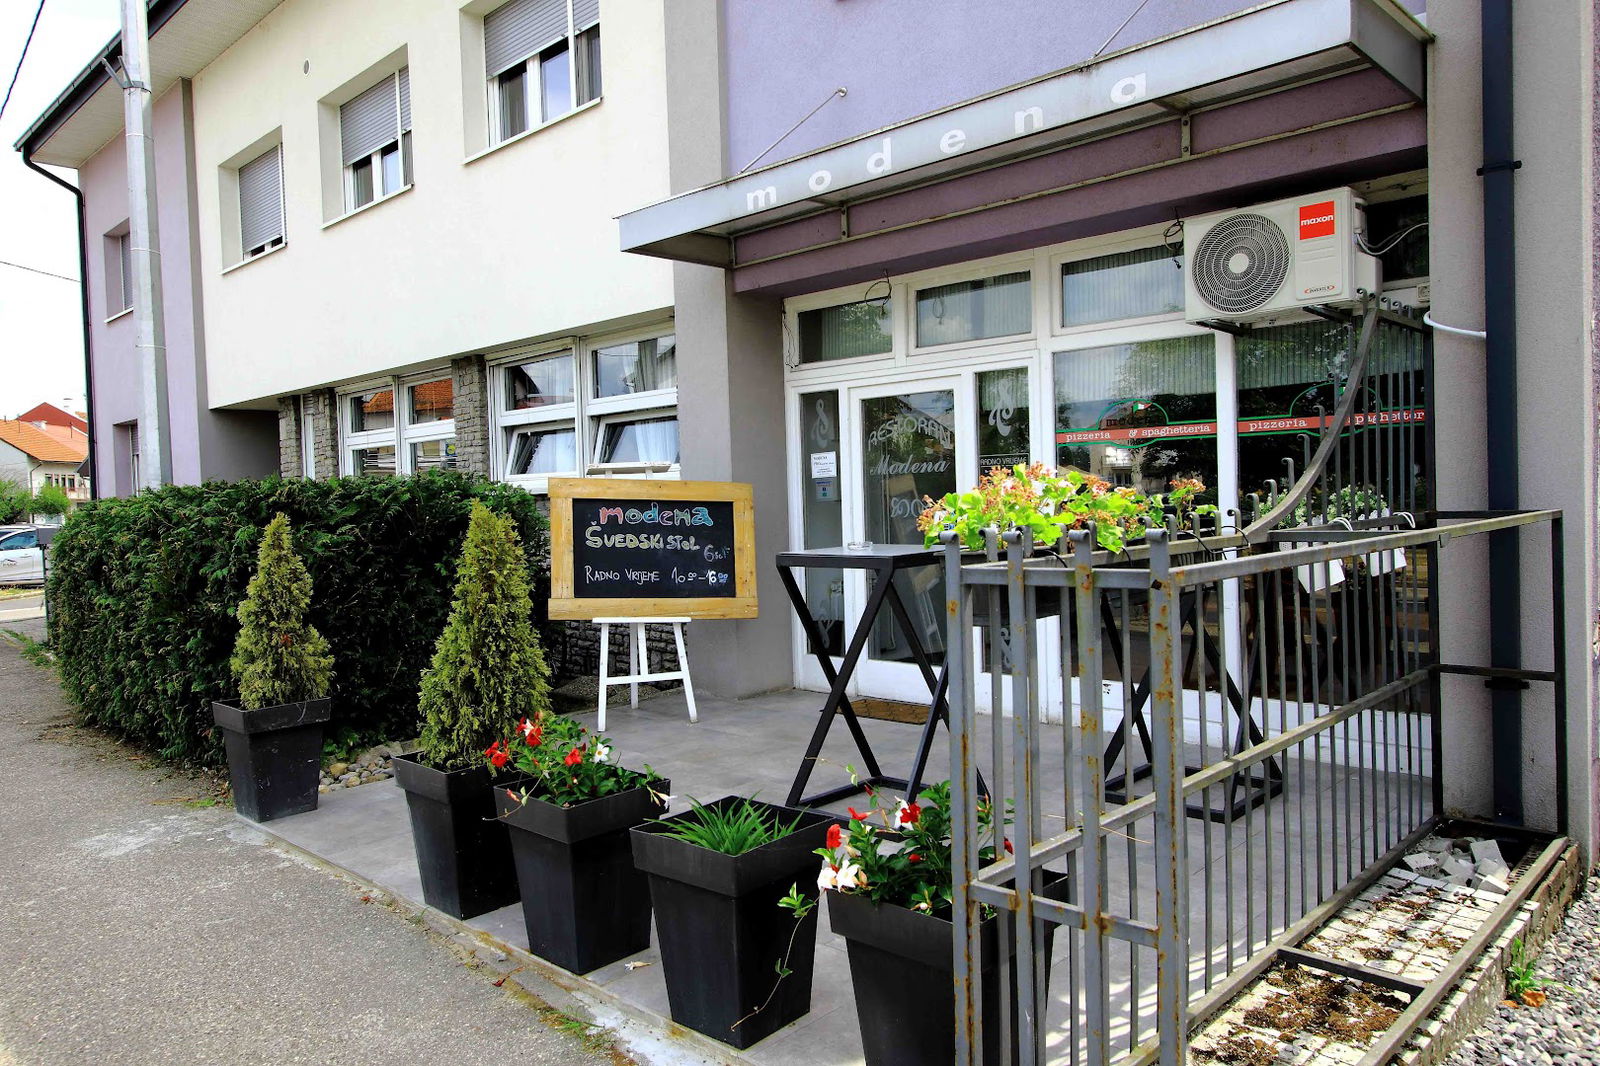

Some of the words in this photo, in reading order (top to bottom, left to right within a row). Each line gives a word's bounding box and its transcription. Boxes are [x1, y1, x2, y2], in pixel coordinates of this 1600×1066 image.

[747, 72, 1147, 212] modena
[1300, 214, 1334, 227] maxon
[1066, 431, 1111, 443] pizzeria
[1128, 429, 1138, 438] &
[1141, 423, 1211, 436] spaghetteria
[1249, 416, 1307, 433] pizzeria
[869, 454, 951, 476] Modena
[599, 502, 713, 527] modena
[584, 565, 620, 584] RADNO
